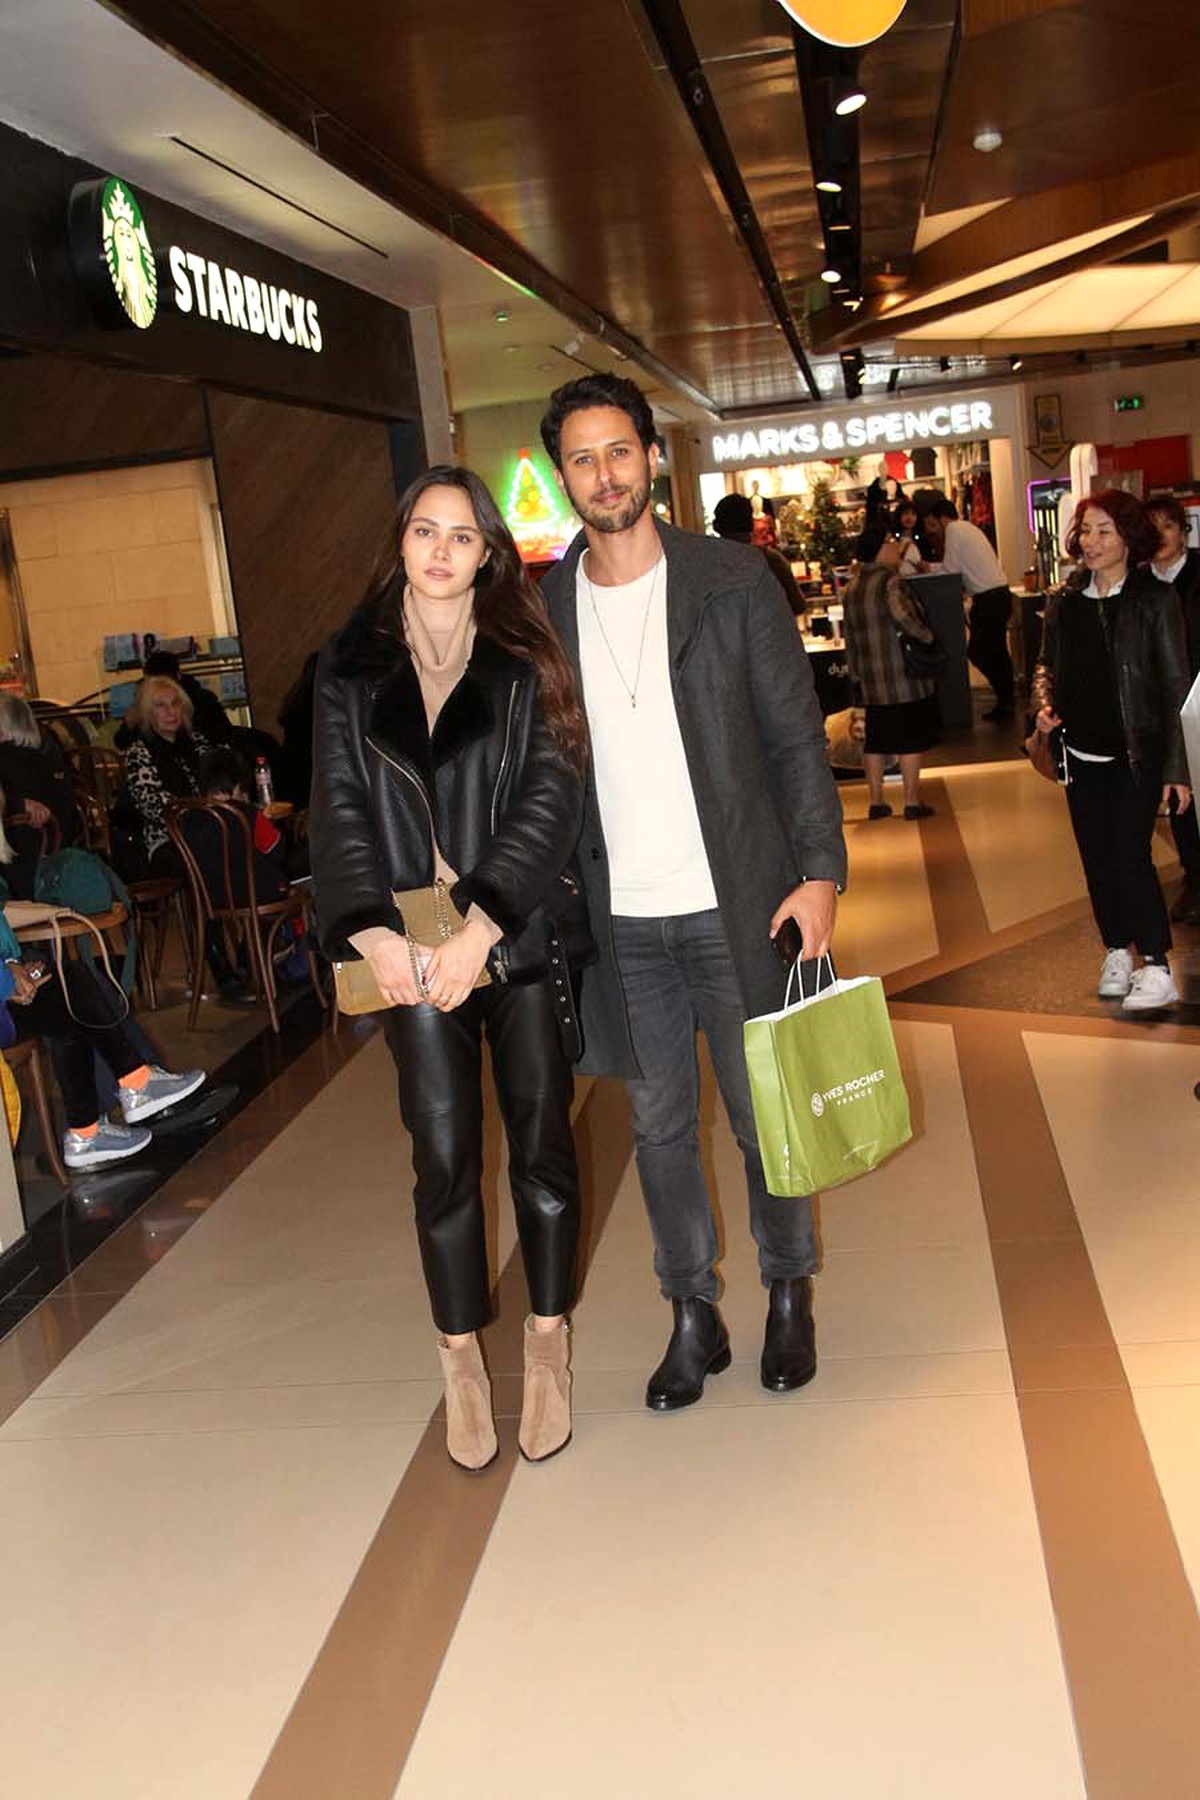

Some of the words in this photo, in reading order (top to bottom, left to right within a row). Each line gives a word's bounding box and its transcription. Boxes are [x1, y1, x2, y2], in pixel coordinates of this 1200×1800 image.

[169, 246, 322, 352] STARBUCKS
[712, 424, 819, 463] MARKS
[821, 421, 844, 449] &
[846, 401, 993, 447] SPENCER
[845, 1069, 885, 1092] ROCHER
